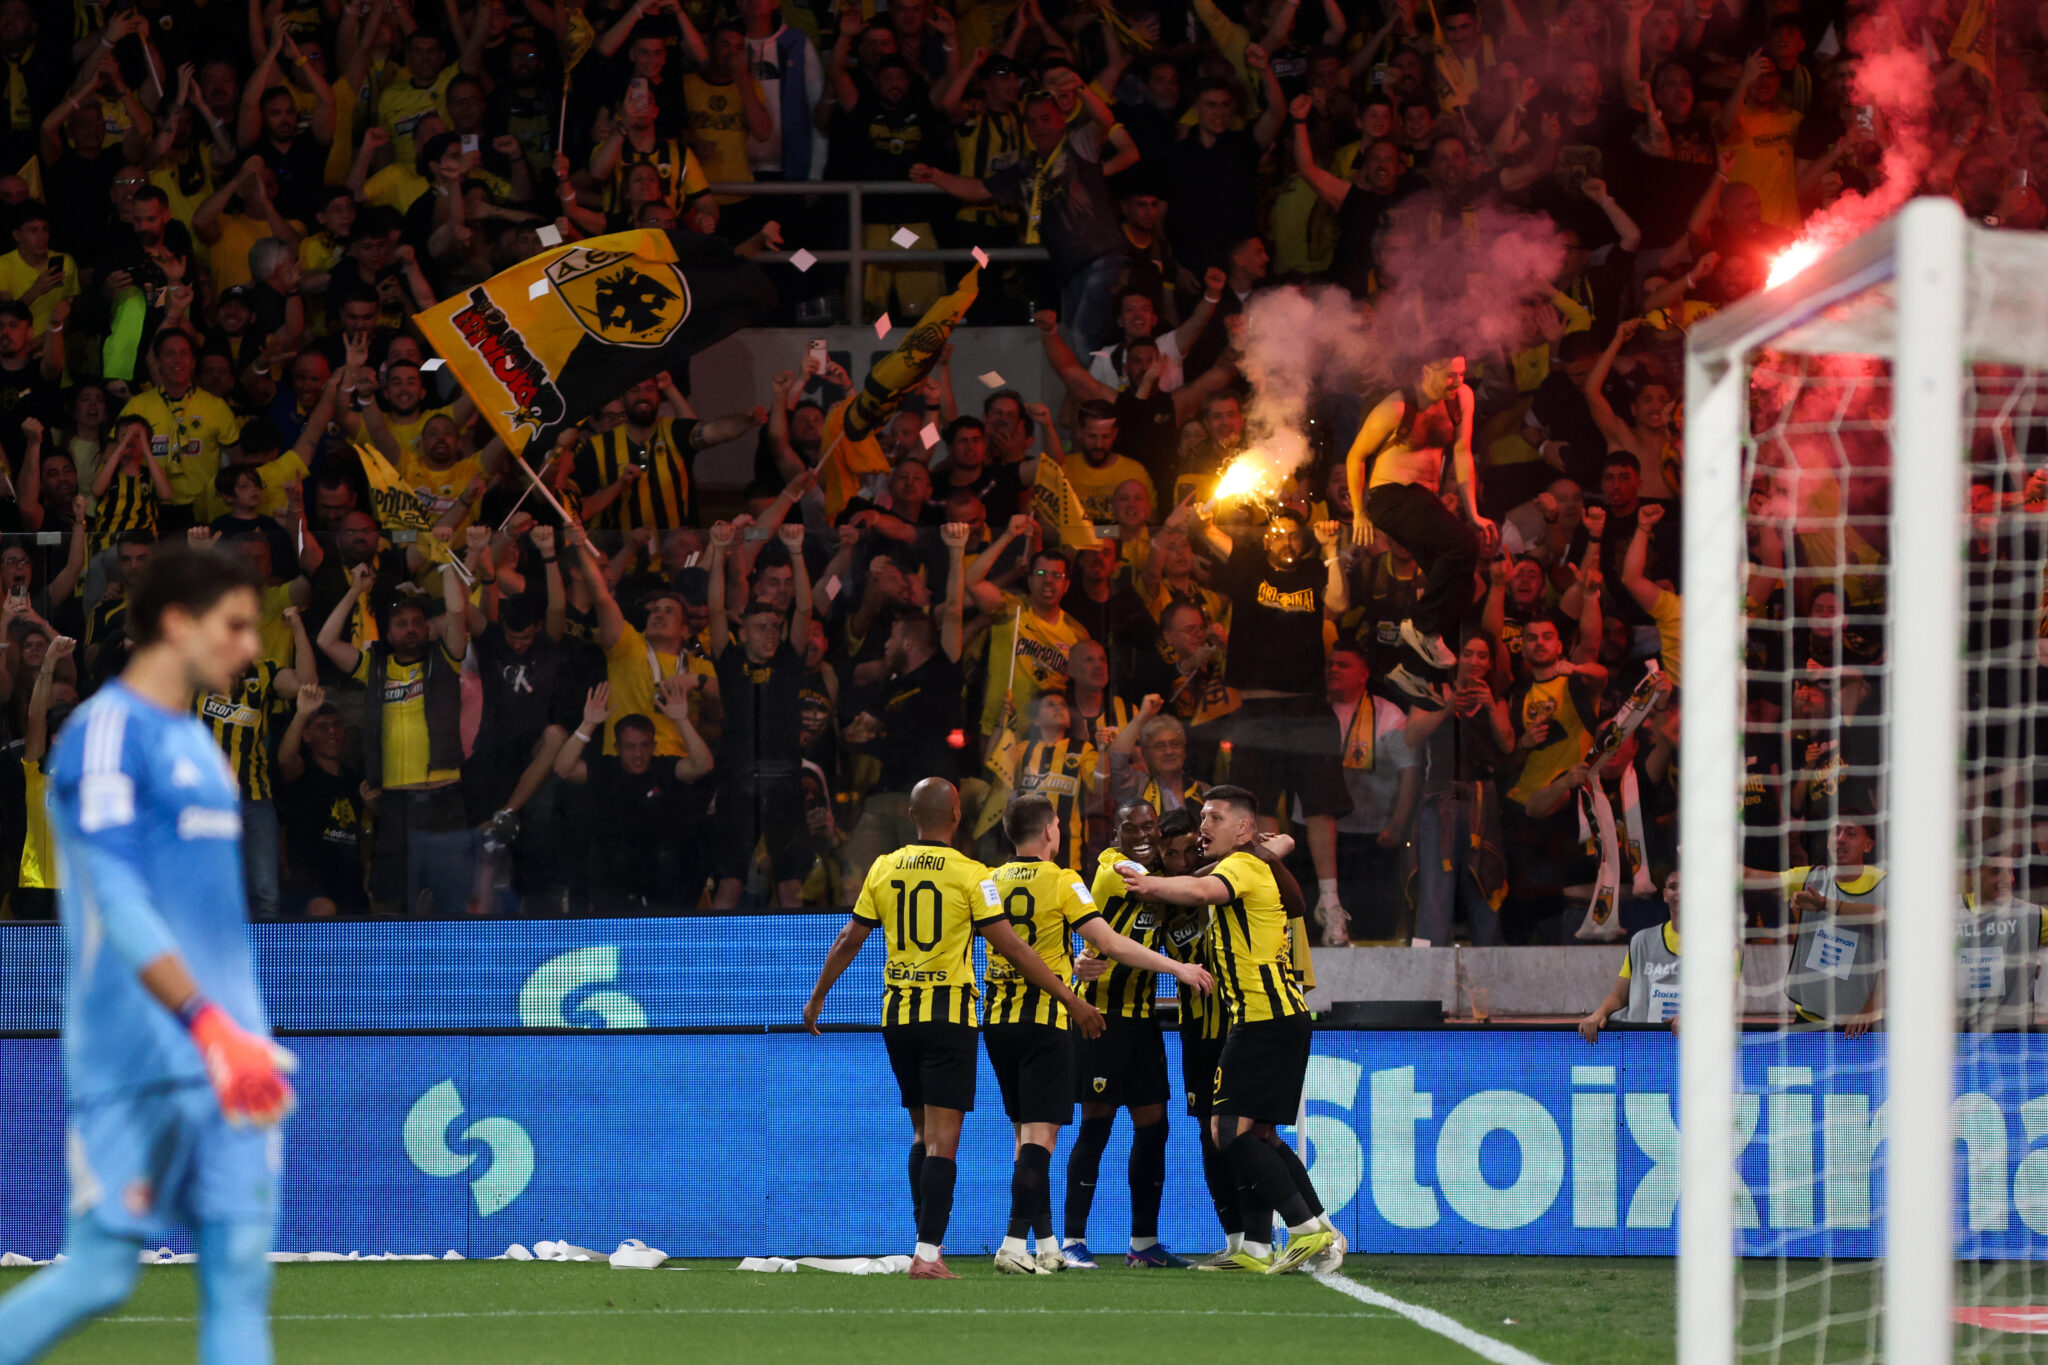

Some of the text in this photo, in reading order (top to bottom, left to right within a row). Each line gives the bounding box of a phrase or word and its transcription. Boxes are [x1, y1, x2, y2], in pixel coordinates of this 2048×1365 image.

[890, 880, 943, 952] 10
[1004, 887, 1038, 947] 8
[1986, 920, 2018, 936] BOY
